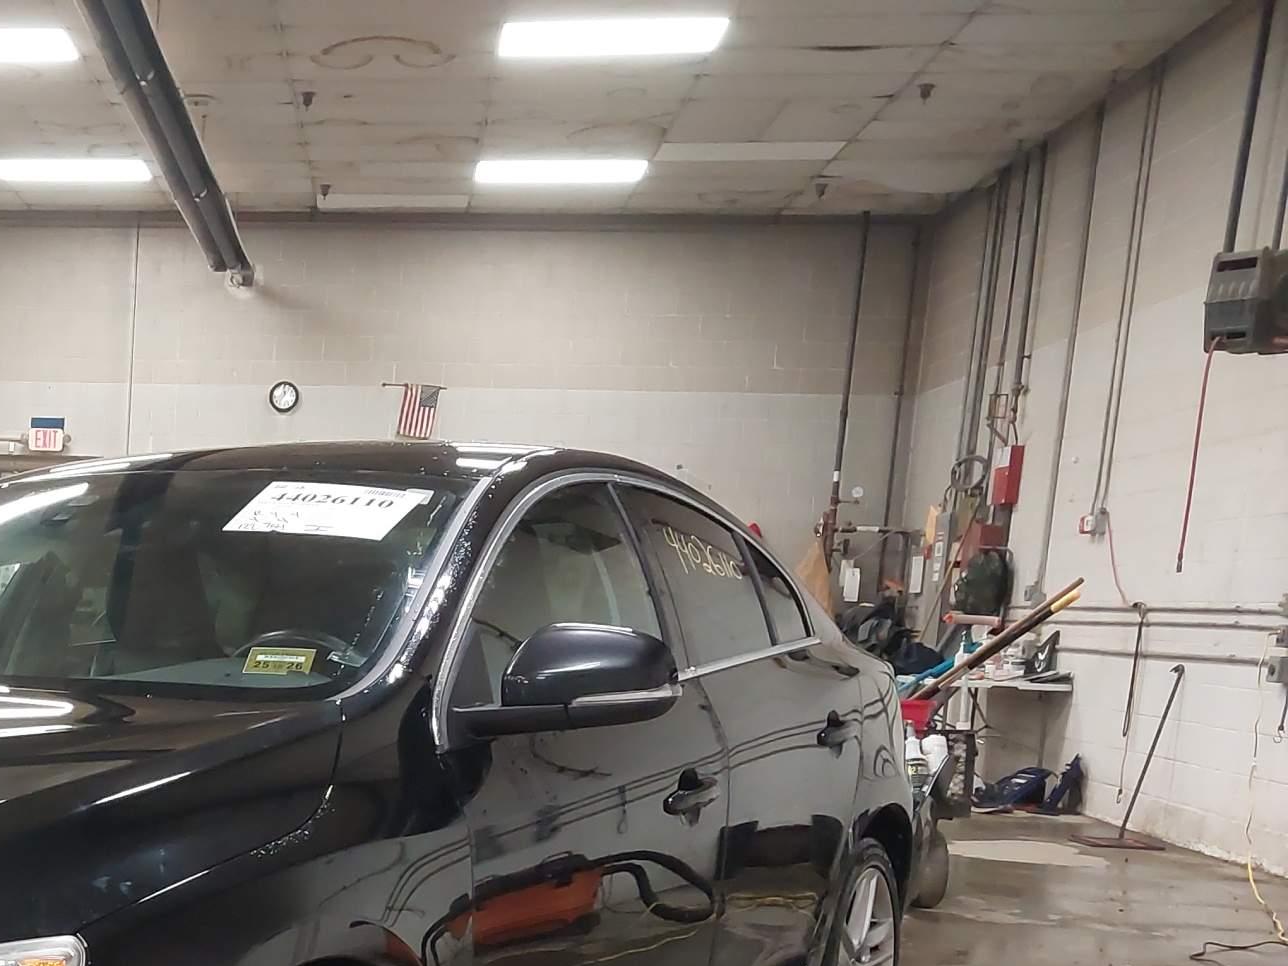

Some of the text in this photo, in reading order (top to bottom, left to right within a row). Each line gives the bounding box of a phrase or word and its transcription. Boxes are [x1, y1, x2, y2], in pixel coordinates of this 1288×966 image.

[35, 429, 58, 449] EXIT
[271, 491, 395, 510] 44026110
[253, 661, 270, 669] 25
[286, 662, 303, 670] 26
